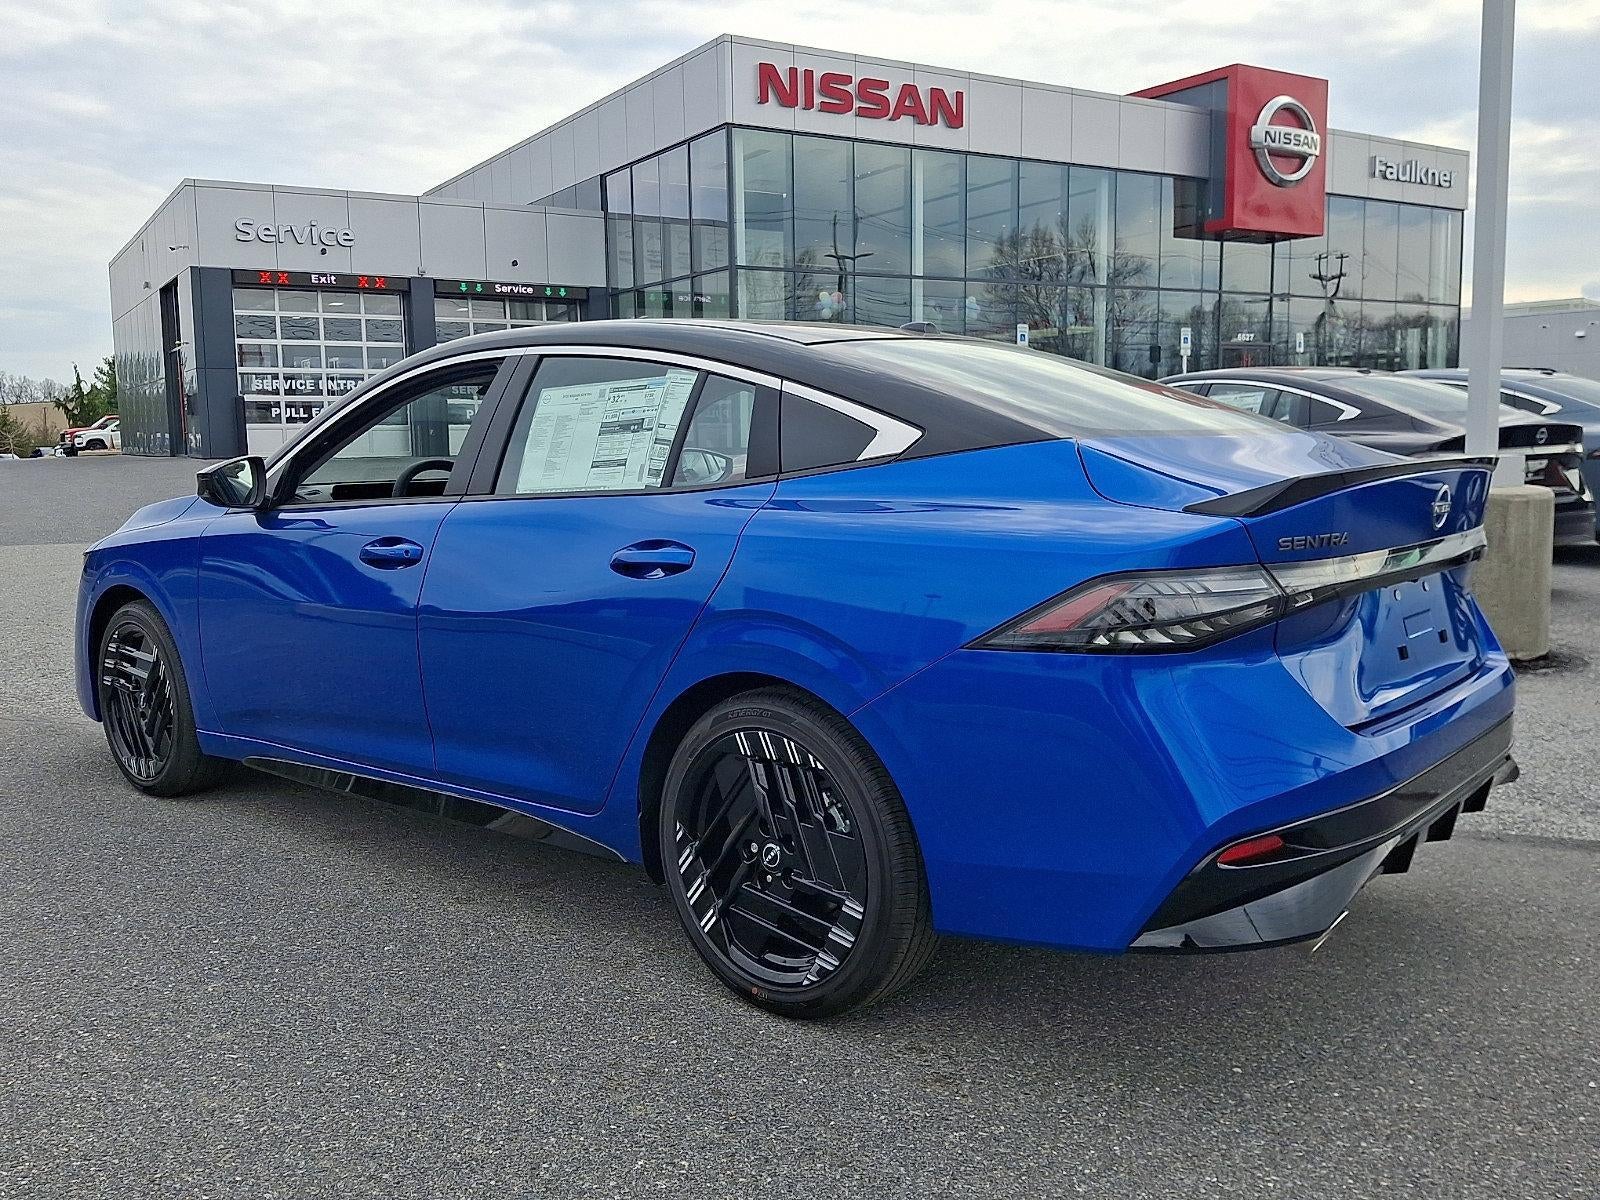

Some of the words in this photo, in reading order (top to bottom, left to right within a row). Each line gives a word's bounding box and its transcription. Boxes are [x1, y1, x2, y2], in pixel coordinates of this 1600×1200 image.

[758, 62, 964, 129] NISSAN
[1264, 130, 1318, 151] NISSAN
[235, 217, 355, 247] Service
[311, 274, 337, 285] Exit
[494, 283, 534, 295] Service
[254, 379, 315, 390] SERVICE
[1278, 531, 1349, 551] SENTRA
